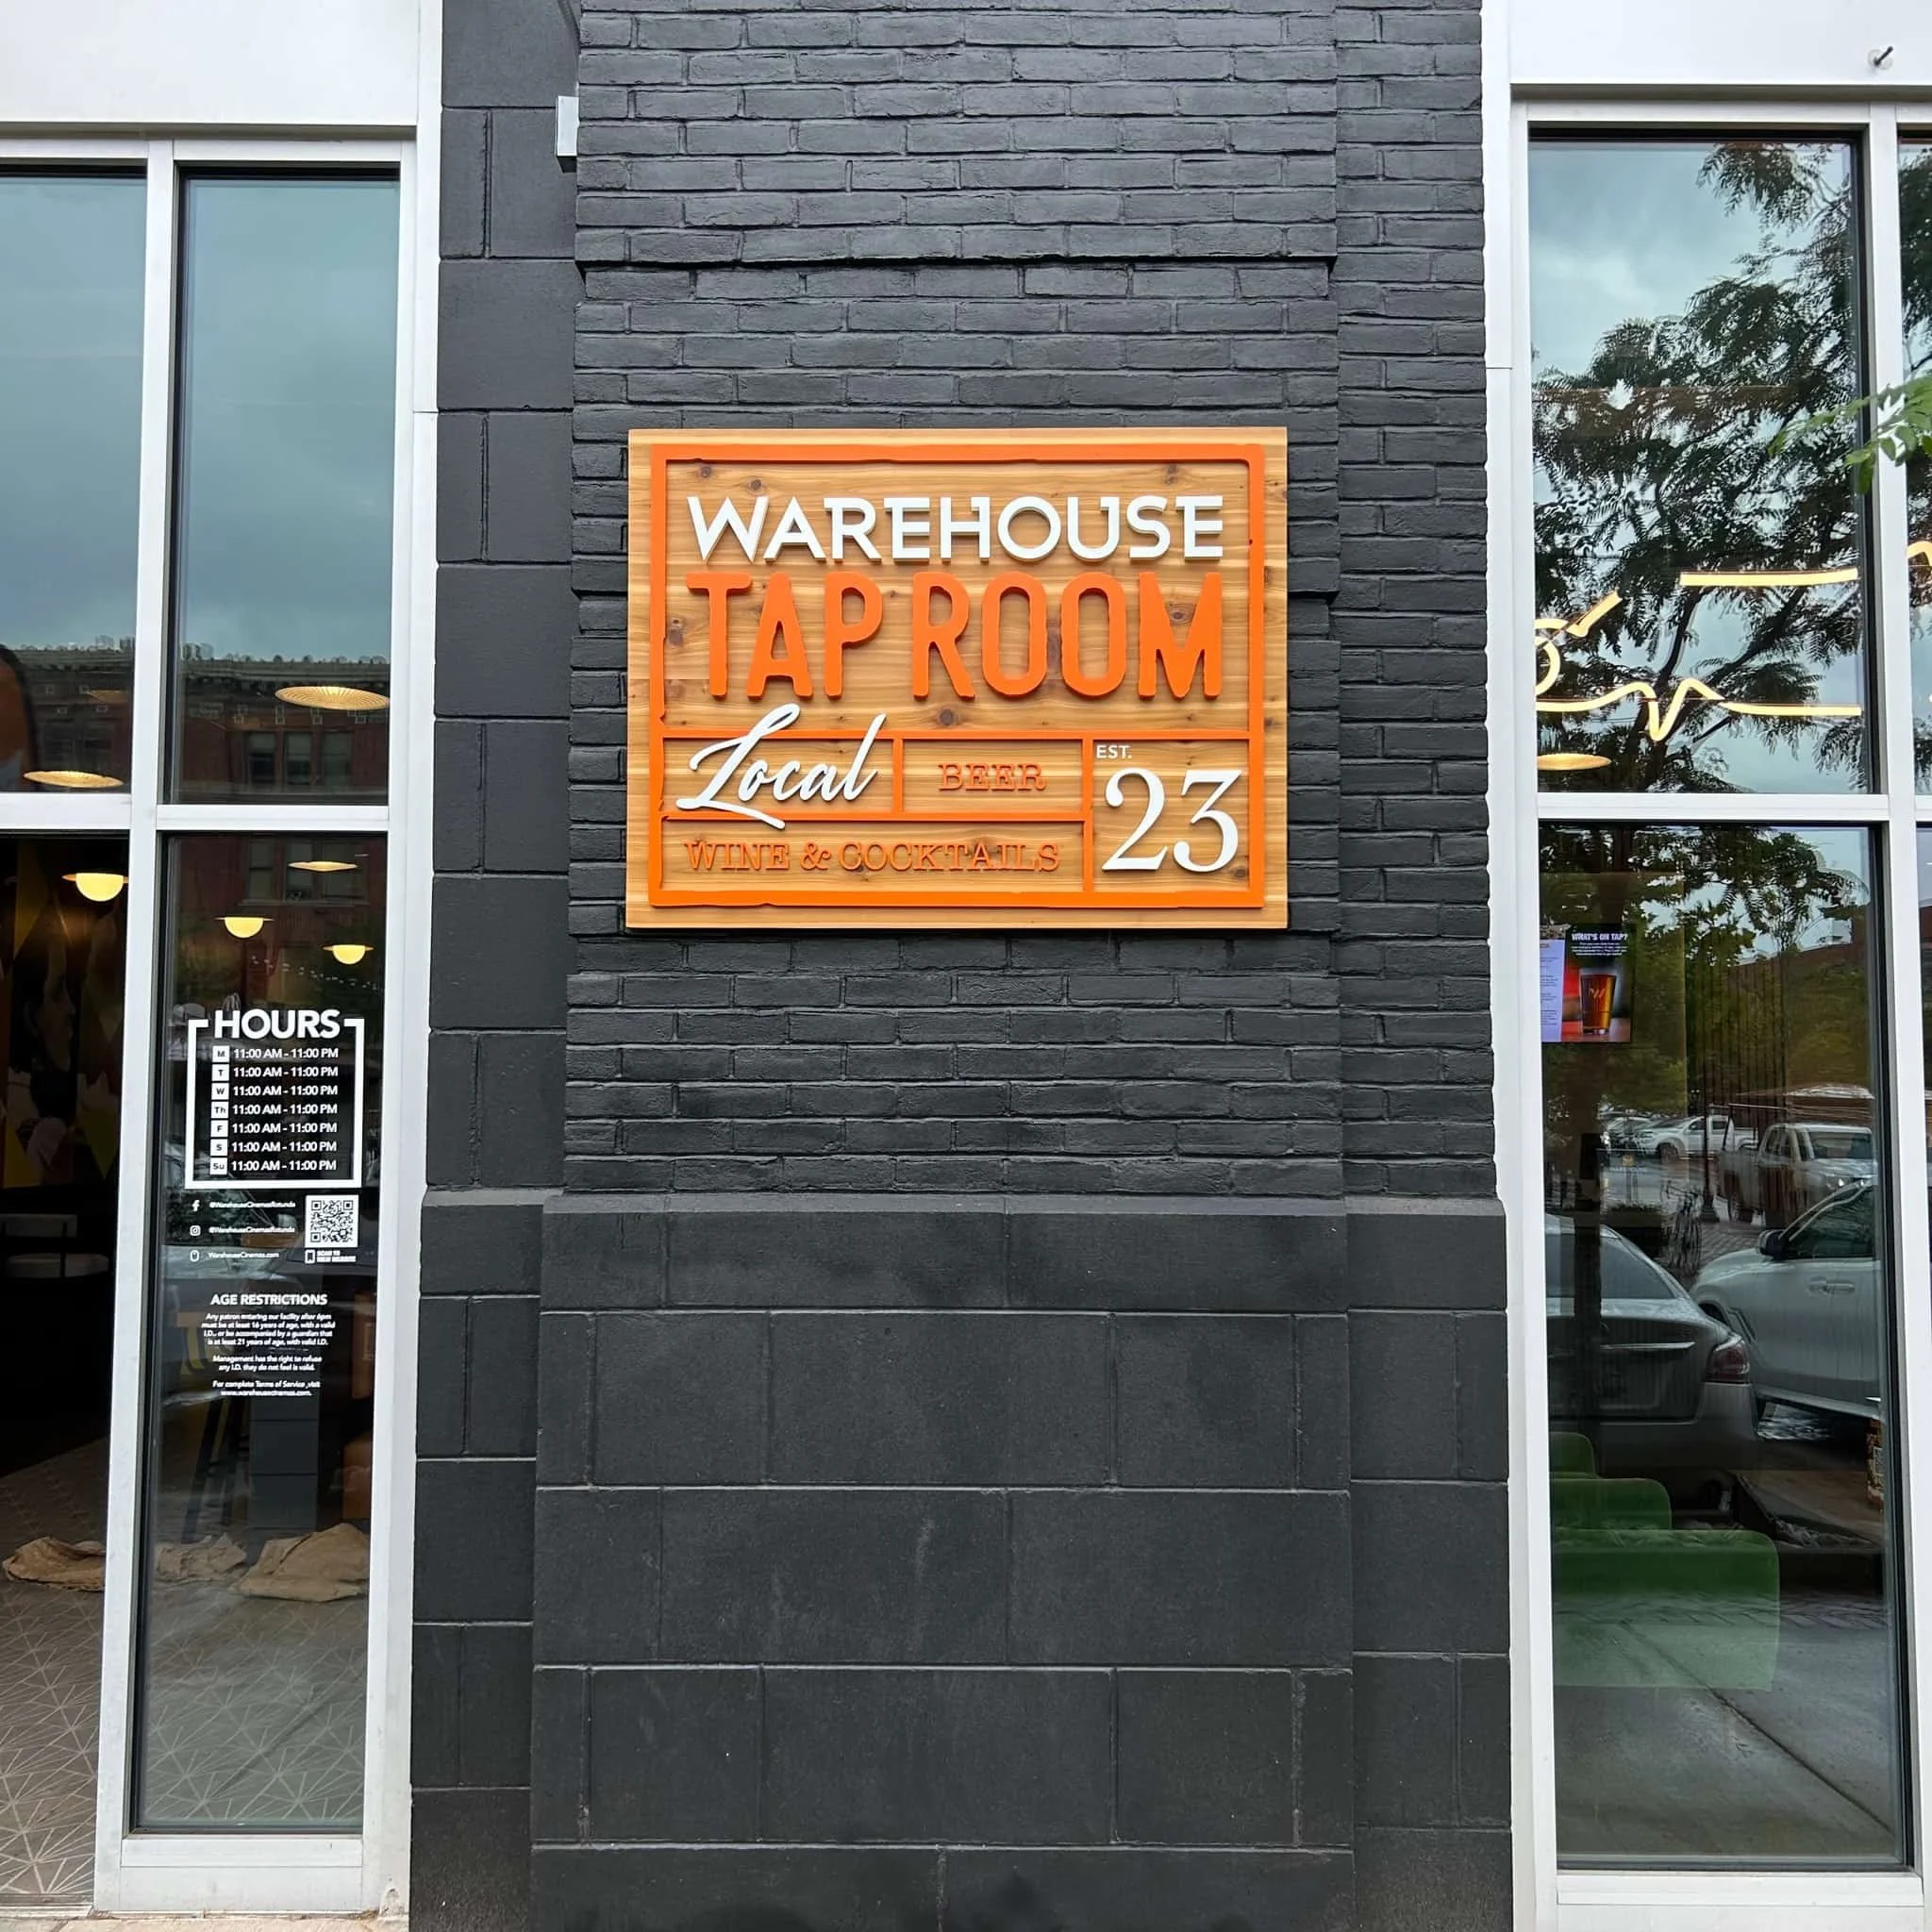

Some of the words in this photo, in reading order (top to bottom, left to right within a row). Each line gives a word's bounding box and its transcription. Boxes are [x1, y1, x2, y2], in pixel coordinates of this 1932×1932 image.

[687, 495, 1224, 563] WAREHOUSE
[686, 571, 883, 700] TAP
[911, 571, 1224, 700] ROOM
[1095, 744, 1133, 759] EST.
[675, 703, 887, 830] Local
[938, 761, 1047, 792] BEER
[1102, 768, 1242, 874] 23
[684, 841, 791, 873] WINE
[798, 842, 832, 872] &
[839, 841, 1061, 874] COCKTAILS
[214, 1008, 341, 1039] HOURS
[233, 1048, 261, 1058] 11:00
[263, 1048, 282, 1058] AM
[291, 1048, 320, 1058] 11:00
[321, 1047, 339, 1058] PM
[233, 1067, 261, 1077] 11:00
[263, 1067, 282, 1077] AM
[291, 1067, 319, 1077] 11:00
[321, 1066, 339, 1076] PM
[216, 1087, 225, 1095] W
[233, 1086, 261, 1096] 11:00
[262, 1086, 282, 1096] AM
[291, 1086, 319, 1096] 11:00
[320, 1085, 339, 1095] PM
[214, 1106, 226, 1114] Th
[232, 1104, 260, 1114] 11:00
[262, 1104, 282, 1114] AM
[290, 1104, 319, 1114] 11:00
[320, 1103, 338, 1113] PM
[232, 1123, 260, 1133] 11:00
[261, 1123, 281, 1133] AM
[289, 1123, 318, 1133] 11:00
[320, 1122, 338, 1132] PM
[216, 1143, 223, 1152] S
[231, 1141, 260, 1152] 11:00
[261, 1141, 281, 1152] AM
[289, 1141, 318, 1152] 11:00
[319, 1141, 338, 1151] PM
[213, 1162, 225, 1171] Su
[231, 1160, 259, 1171] 11:00
[260, 1160, 280, 1171] AM
[289, 1160, 317, 1171] 11:00
[319, 1159, 337, 1170] PM
[210, 1294, 238, 1306] AGE
[240, 1294, 328, 1306] RESTRICTIONS
